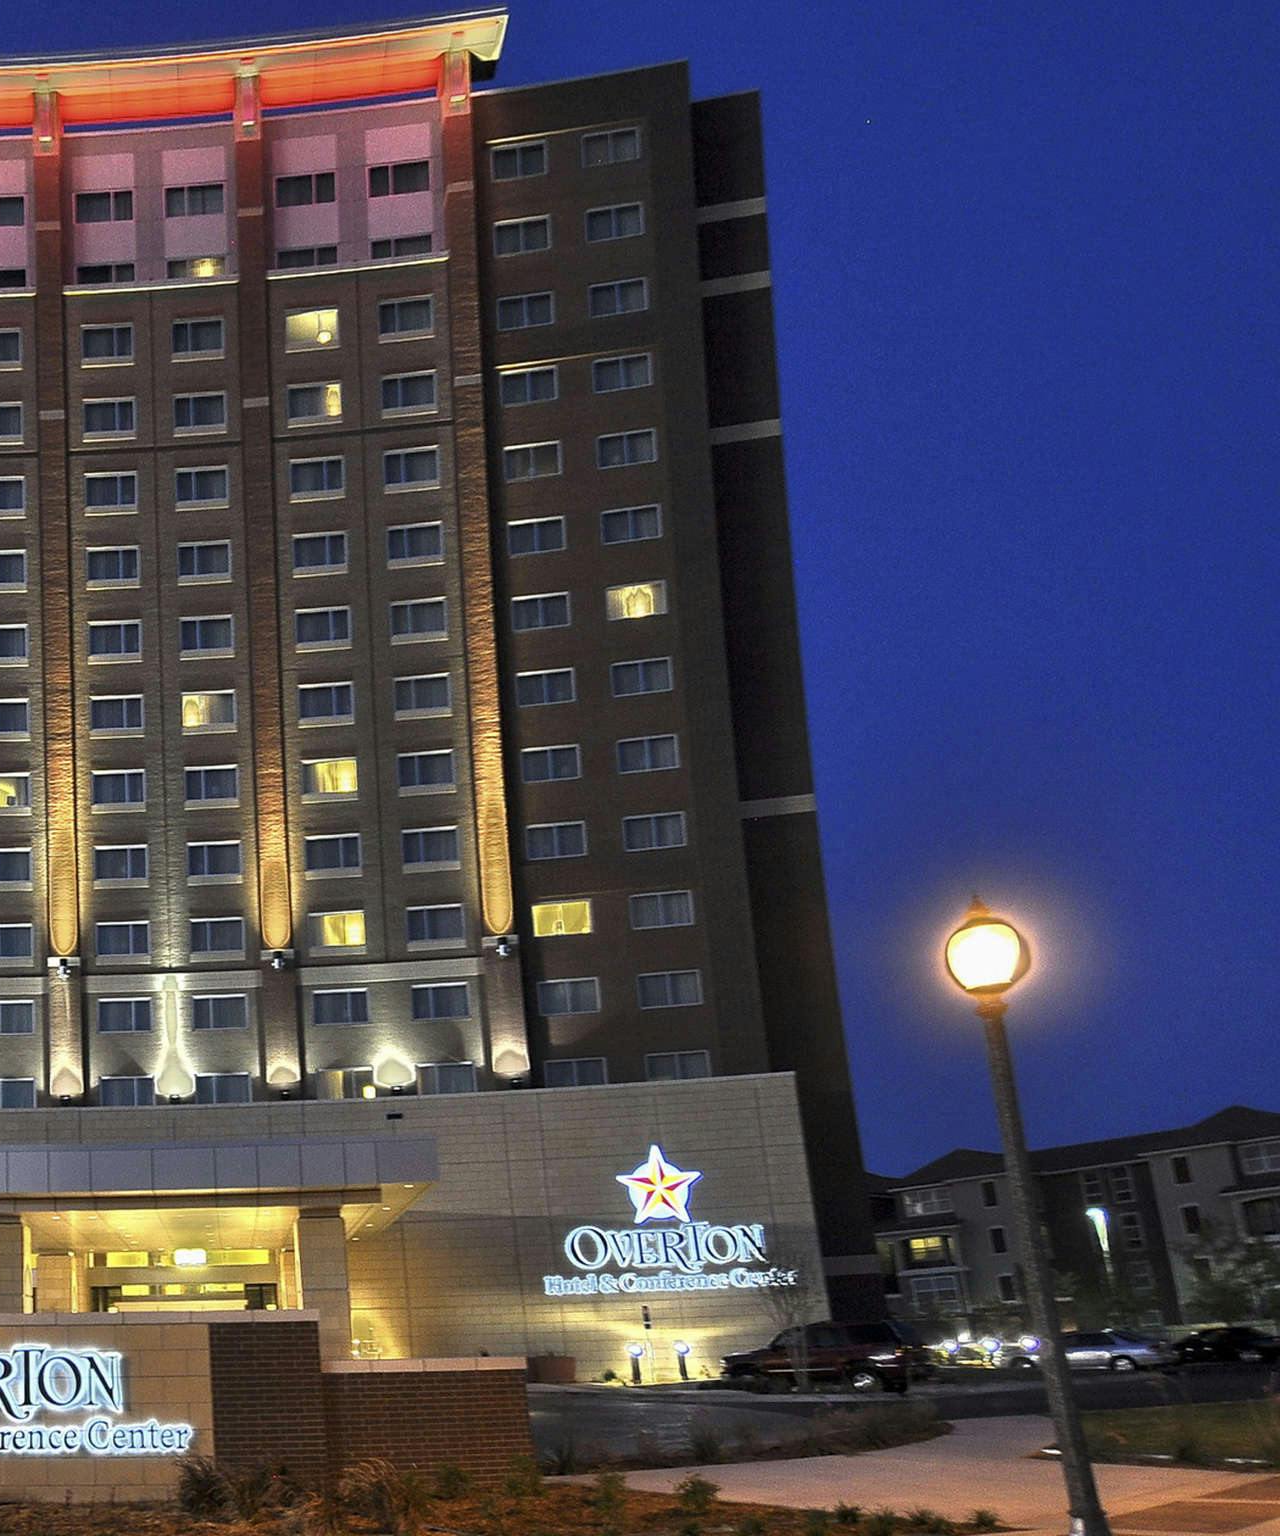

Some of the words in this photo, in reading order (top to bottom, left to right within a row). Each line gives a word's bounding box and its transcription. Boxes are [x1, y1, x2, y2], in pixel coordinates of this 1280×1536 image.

[564, 1220, 768, 1274] OVERTON
[544, 1273, 599, 1296] Hotel
[599, 1273, 619, 1294] &
[620, 1269, 729, 1293] Conference
[86, 1419, 190, 1452] Center
